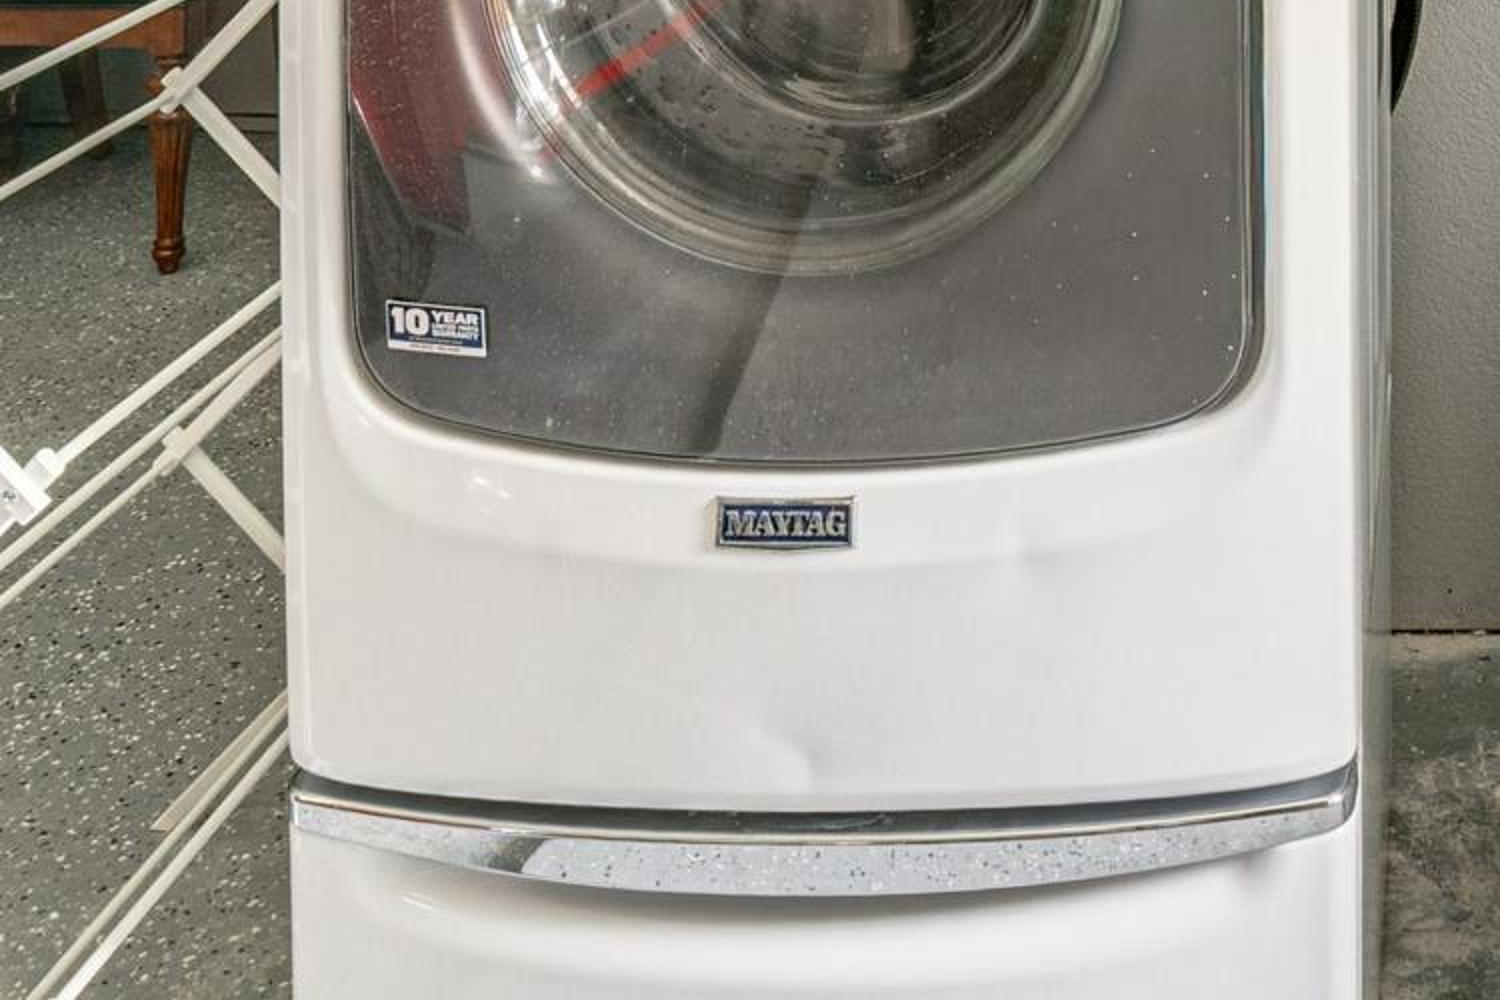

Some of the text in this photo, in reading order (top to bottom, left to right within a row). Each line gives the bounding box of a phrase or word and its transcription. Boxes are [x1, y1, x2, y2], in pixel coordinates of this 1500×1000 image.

[391, 306, 479, 336] 10 YEAR
[724, 509, 848, 537] MAYTAG
